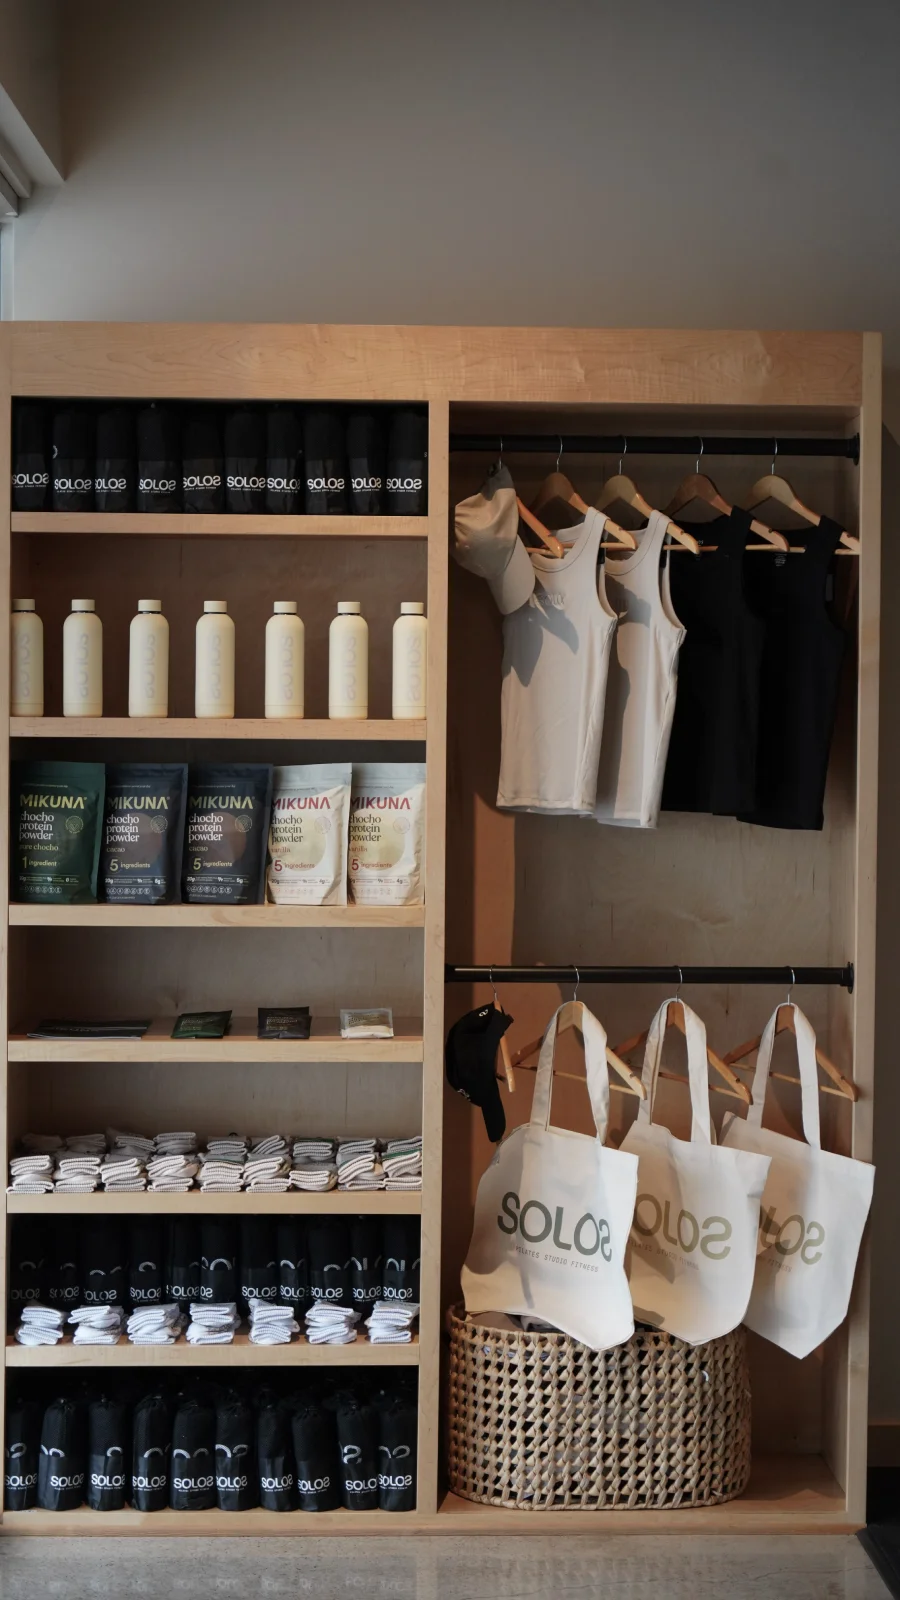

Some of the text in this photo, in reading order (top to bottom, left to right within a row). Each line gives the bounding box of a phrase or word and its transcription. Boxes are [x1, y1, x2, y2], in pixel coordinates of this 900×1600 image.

[54, 478, 92, 490] SOLOS
[139, 478, 177, 491] SOLOS
[227, 476, 266, 489] SOLOS
[307, 477, 345, 490] SOLOS
[386, 477, 422, 490] SOLOS
[20, 794, 85, 810] MIKUNA
[107, 796, 169, 810] MIKUNA
[189, 796, 254, 809] MIKUNA
[271, 796, 331, 810] MIKUNA
[350, 796, 411, 810] MIKUNA
[21, 811, 55, 822] chocho
[106, 813, 140, 824] chocho
[188, 813, 224, 823] chocho
[20, 821, 53, 833] protein
[106, 823, 139, 835] protein
[188, 822, 222, 834] protein
[271, 824, 302, 835] protein
[20, 830, 54, 842] powder
[106, 832, 140, 844] powder
[188, 831, 224, 844] powder
[271, 833, 304, 845] powder
[33, 843, 59, 851] chocho
[22, 856, 27, 869] 1
[109, 858, 119, 871] 5
[193, 858, 233, 870] 5 ingredients
[274, 859, 283, 872] 5
[351, 858, 359, 871] 5
[497, 1191, 613, 1262] SOLOS
[631, 1193, 733, 1260] OLOS
[759, 1205, 826, 1265] LOS
[515, 1245, 599, 1272] PILATES STUDIO FITNESS
[242, 1286, 277, 1298] SOLOS
[383, 1287, 413, 1299] SOLOS
[50, 1473, 85, 1487] SOLOS
[132, 1475, 167, 1488] SOLOS
[173, 1475, 214, 1489] SOLOS
[261, 1474, 293, 1489] SOLOS
[345, 1478, 377, 1491] SOLO
[378, 1473, 413, 1487] SOLOS
